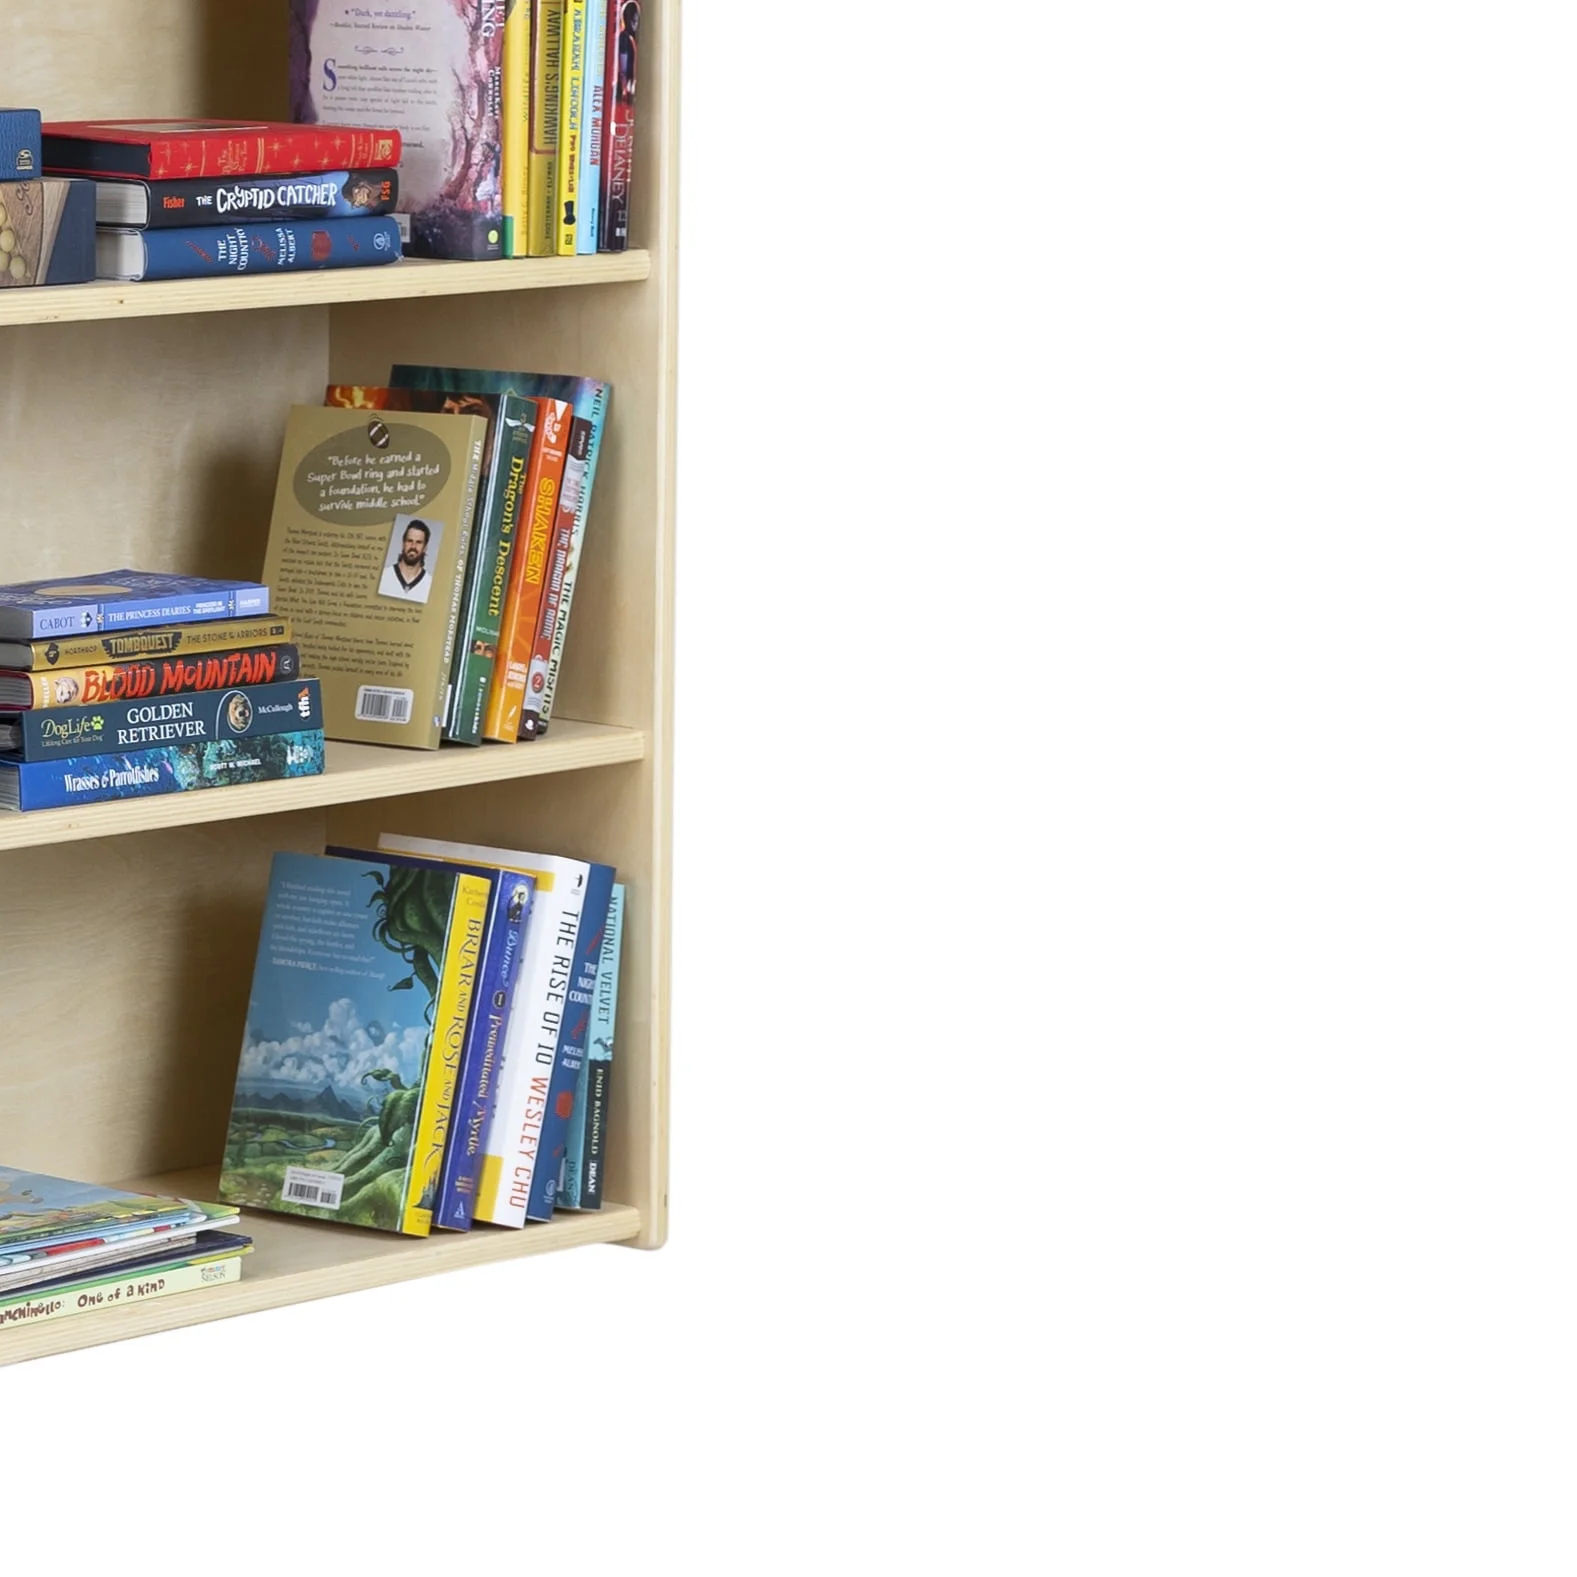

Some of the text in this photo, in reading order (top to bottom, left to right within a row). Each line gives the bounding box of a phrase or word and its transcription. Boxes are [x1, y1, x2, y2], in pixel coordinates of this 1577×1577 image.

[543, 9, 561, 145] HAWKING'S HALLWAY
[611, 123, 627, 204] DELANEY
[163, 195, 185, 209] Fisher
[195, 183, 337, 213] THE CRYPTID CATCHER
[217, 239, 227, 262] THE
[228, 235, 238, 266] NIGHT
[237, 228, 248, 271] COUNTRY
[277, 227, 285, 266] MELISSA
[287, 228, 297, 263] ALBERT
[590, 388, 603, 418] NEIL
[328, 451, 421, 467] "Before he earned a
[472, 439, 482, 461] THE
[307, 463, 440, 485] Super Bowl ring and started
[320, 480, 426, 497] a foundation, he had to
[318, 500, 353, 512] survive
[355, 497, 388, 509] middle
[488, 456, 524, 616] Dragon's Descent
[526, 477, 556, 584] SHAKEN
[559, 528, 571, 549] THE
[456, 559, 464, 571] OF
[451, 572, 462, 608] THOMAS
[40, 617, 75, 631] CABOT
[108, 604, 191, 623] THE PRINCESS DIARIES
[64, 645, 98, 655] NORTHROP
[109, 633, 174, 654] TOMBQUEST
[187, 628, 268, 643] THE STONE WARRIORS
[444, 611, 456, 664] MORSTEAD
[542, 581, 573, 714] THE MAGIC MISFITS
[81, 665, 155, 704] BLOOD
[160, 652, 276, 695] MOUNTAIN
[533, 675, 542, 689] 2
[127, 702, 193, 723] GOLDEN
[258, 703, 293, 714] McCullough
[41, 716, 91, 738] DogLife
[117, 720, 207, 745] RETRIEVER
[64, 772, 100, 793] Wrasses
[109, 765, 160, 787] Parrotfishes
[556, 909, 579, 946] THE
[458, 918, 481, 987] BRIAR
[501, 929, 519, 987] Bunce
[598, 896, 618, 1024] NATIONAL VELVET
[546, 955, 570, 1002] RISE
[457, 990, 470, 1012] AND
[541, 1011, 560, 1037] OF
[442, 1016, 465, 1076] ROSE
[442, 1079, 454, 1101] AND
[467, 1014, 503, 1157] Premeditated Myrtle
[517, 1076, 549, 1161] WESLEY
[591, 1068, 603, 1154] ENID BAGNOLD
[424, 1102, 449, 1165] JACK
[509, 1165, 532, 1209] CHU
[567, 1161, 576, 1191] DEAN
[588, 1162, 597, 1193] DEAN
